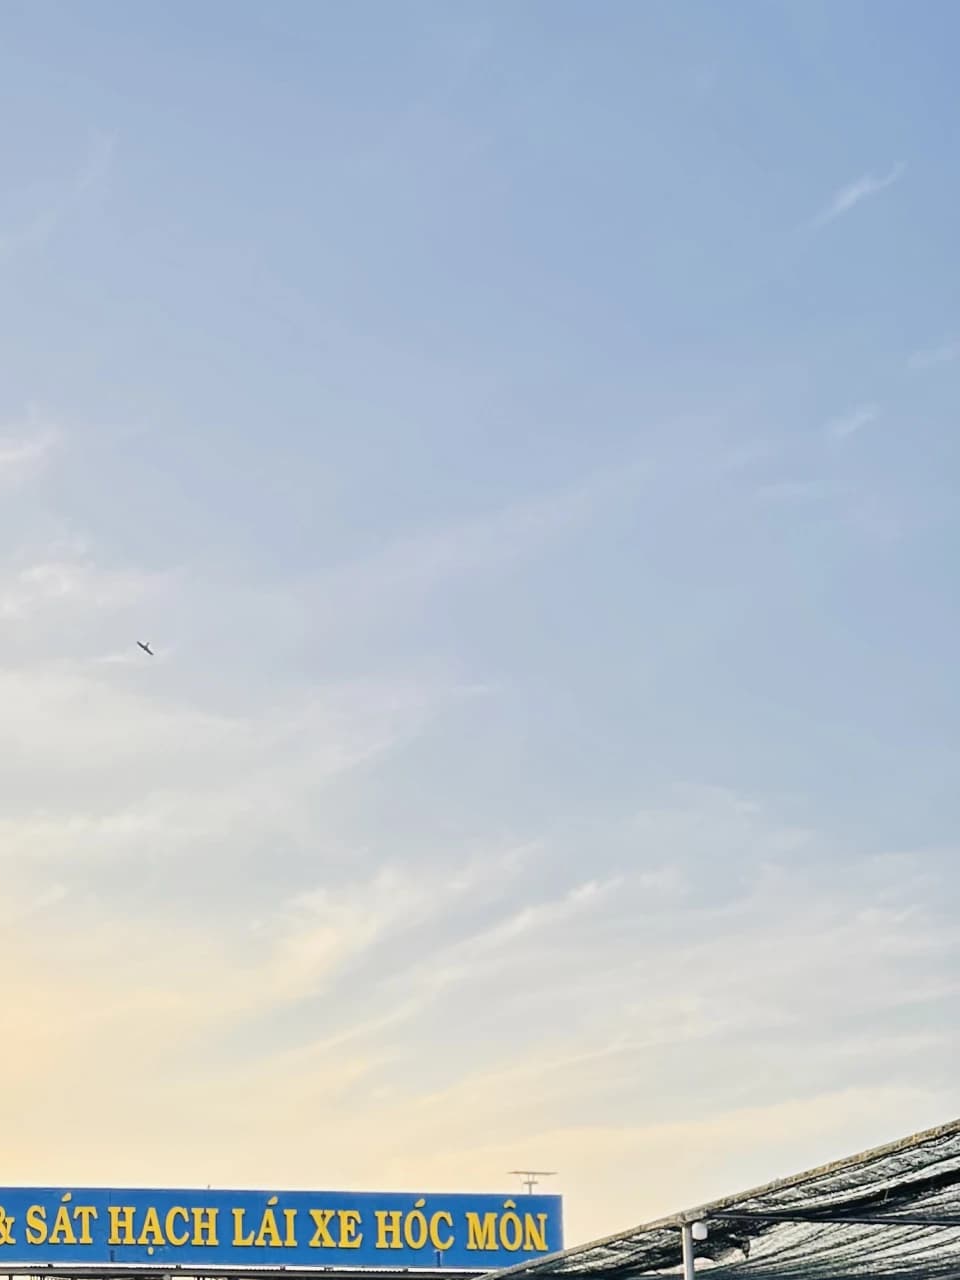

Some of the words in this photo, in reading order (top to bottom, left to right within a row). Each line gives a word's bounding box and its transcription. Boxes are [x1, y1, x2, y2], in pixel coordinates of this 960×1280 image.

[25, 1192, 98, 1246] SÁT
[108, 1205, 219, 1255] HẠCH
[232, 1196, 298, 1248] LÁI
[309, 1208, 363, 1249] XE
[375, 1198, 454, 1251] HÓC
[466, 1199, 548, 1252] MÔN
